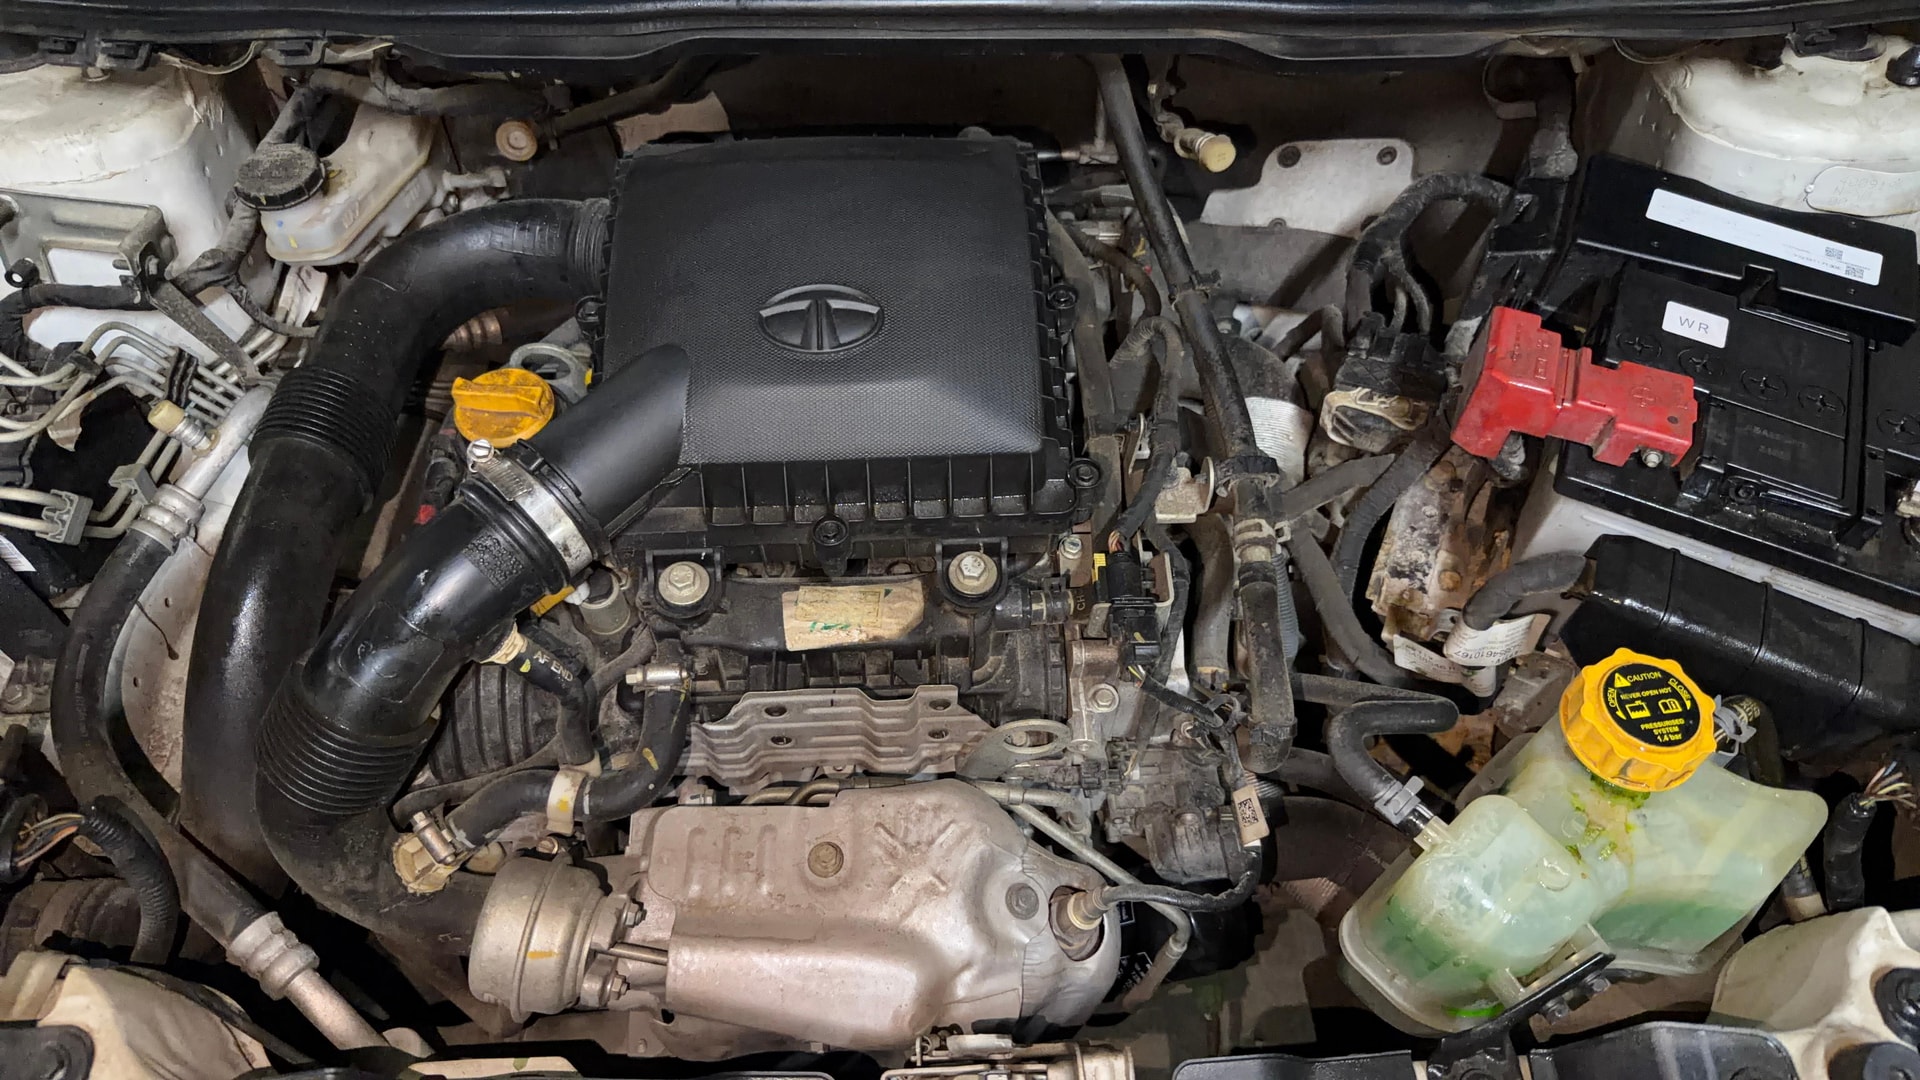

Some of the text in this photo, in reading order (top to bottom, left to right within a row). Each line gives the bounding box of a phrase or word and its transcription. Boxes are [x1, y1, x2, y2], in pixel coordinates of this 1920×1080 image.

[533, 651, 574, 682] AF END
[1626, 672, 1662, 682] CAUTION
[1621, 687, 1672, 700] NEVER OPEN HOT
[1668, 677, 1692, 701] CLOSE
[1607, 687, 1616, 708] OPEN
[1640, 718, 1685, 730] PRESSURISED
[1653, 726, 1679, 735] SYSTEM
[1669, 733, 1683, 741] bar
